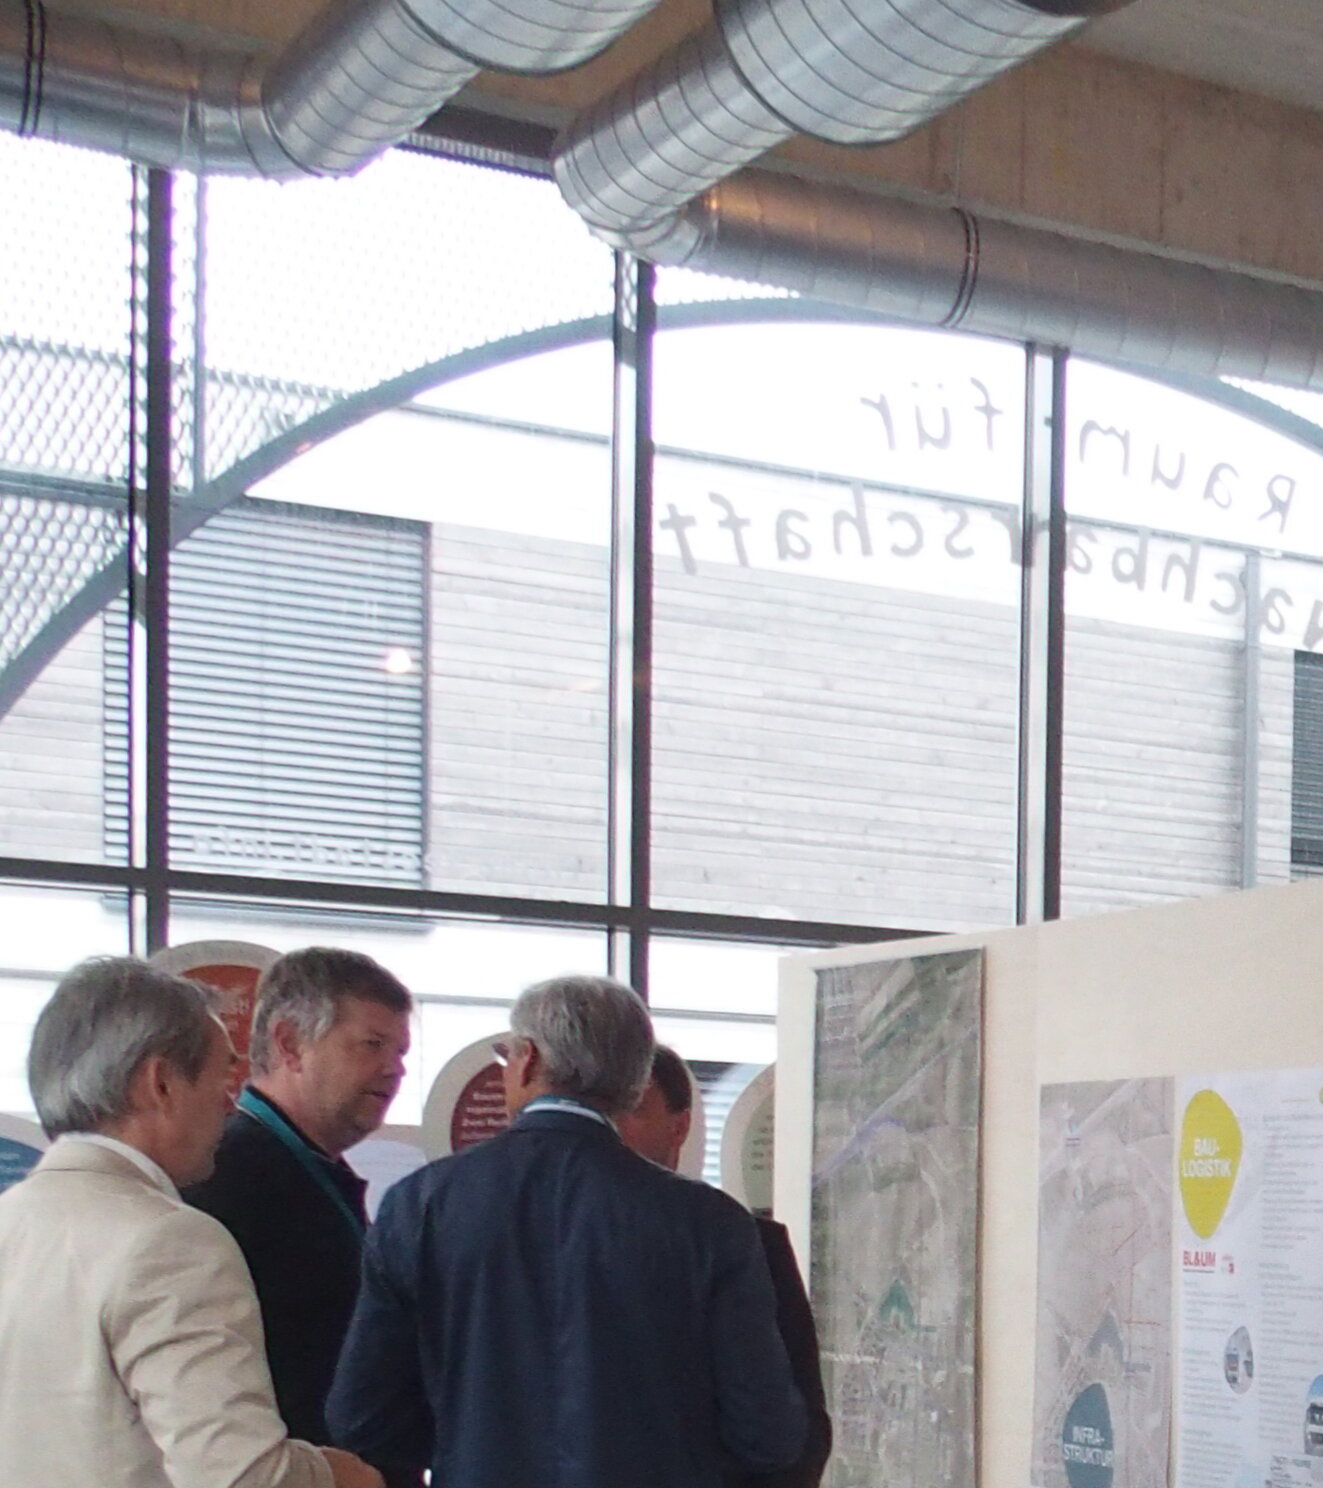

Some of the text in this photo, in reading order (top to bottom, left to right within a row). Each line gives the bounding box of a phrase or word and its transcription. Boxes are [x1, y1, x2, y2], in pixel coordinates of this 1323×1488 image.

[1192, 1137, 1221, 1157] BAU-
[1181, 1157, 1232, 1178] LOGISTIK
[1182, 1250, 1217, 1268] BL&UM
